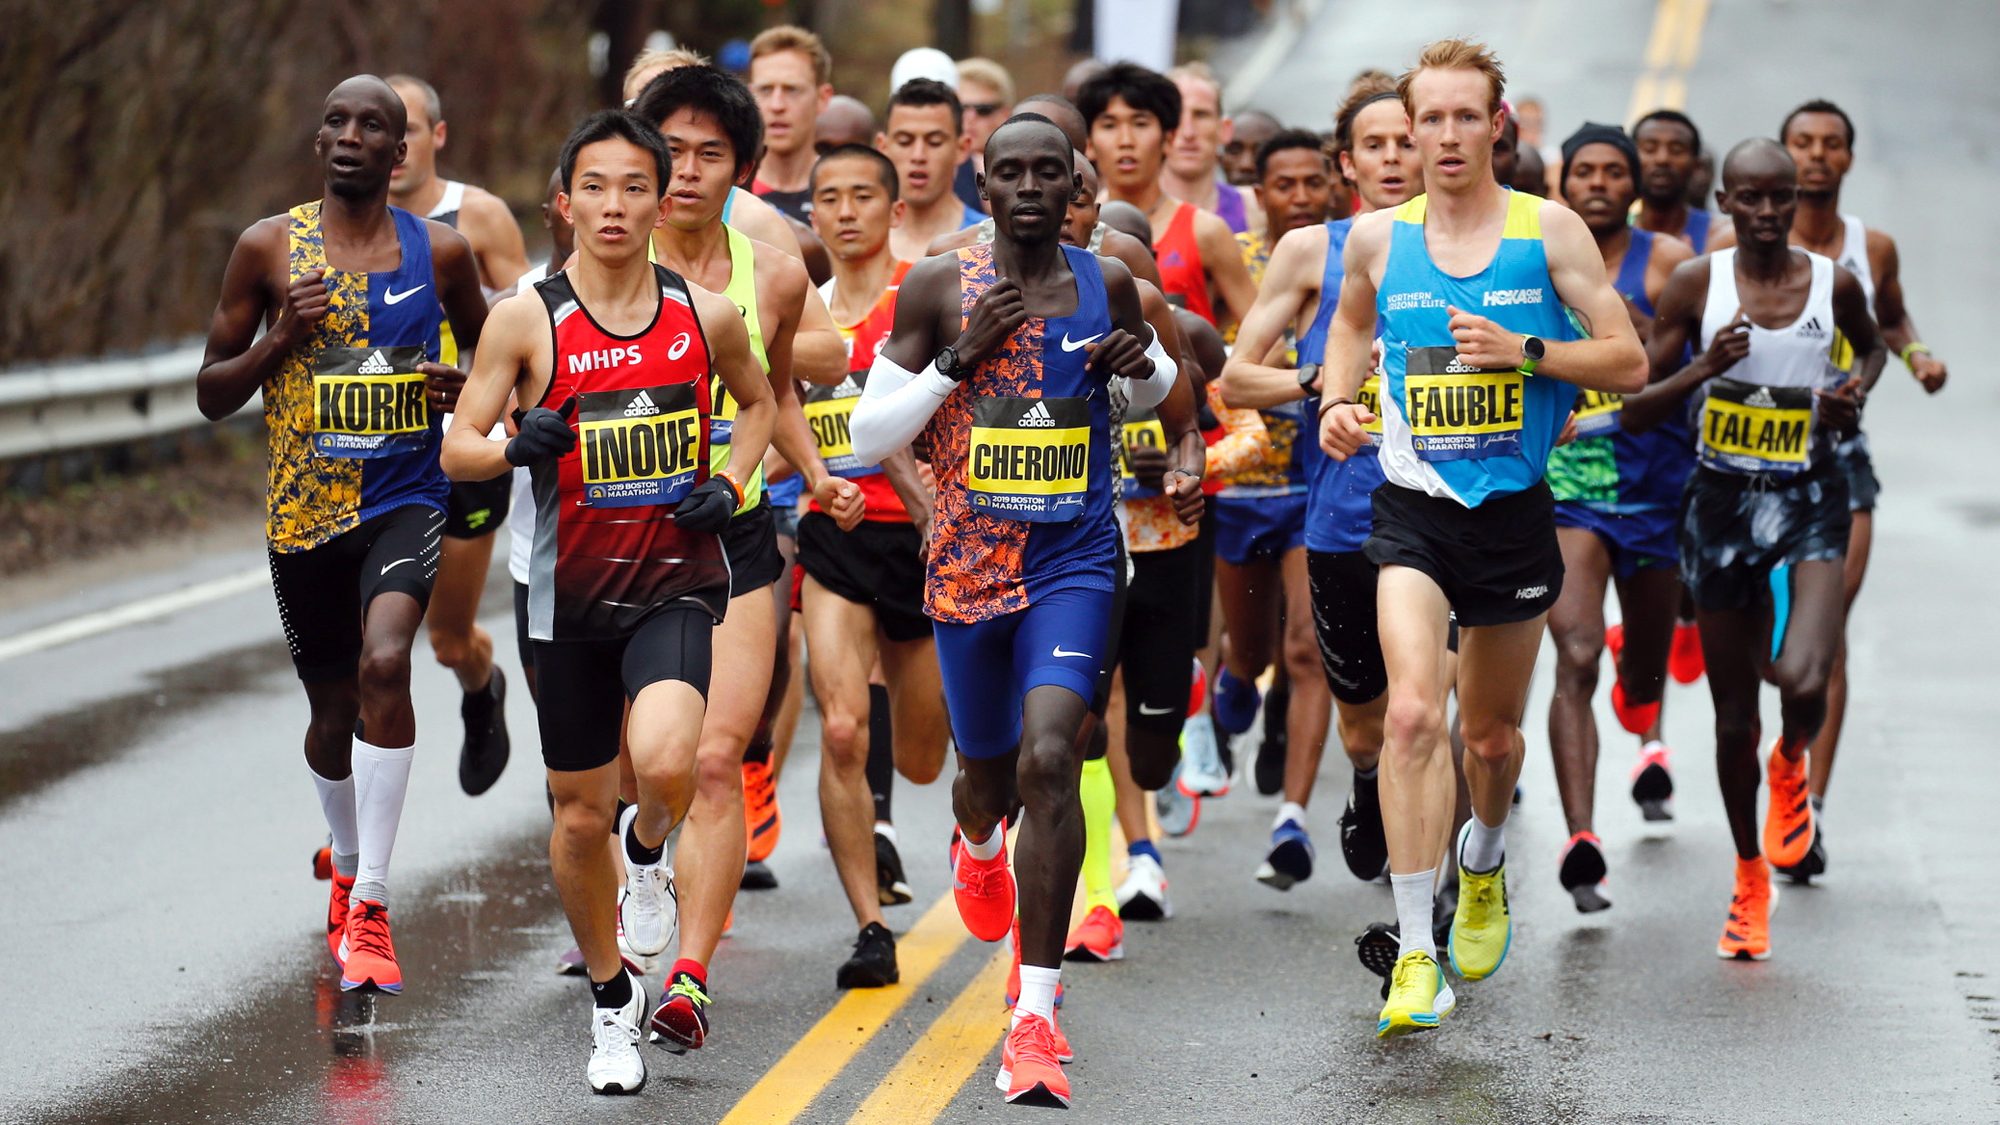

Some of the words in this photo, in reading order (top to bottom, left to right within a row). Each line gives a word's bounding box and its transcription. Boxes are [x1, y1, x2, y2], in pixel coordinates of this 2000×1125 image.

[1421, 299, 1446, 308] ELITE
[568, 345, 643, 374] MHPS
[358, 365, 394, 374] adidas
[320, 381, 426, 432] KORIR
[1410, 383, 1520, 428] FAUBLE
[624, 405, 660, 417] adidas
[1018, 418, 1056, 427] adidas
[1708, 409, 1807, 453] TALAM
[336, 441, 384, 449] MARATHO
[1445, 436, 1475, 444] BOSTON
[585, 416, 697, 480] INOUE
[1428, 443, 1476, 451] MARATHON
[974, 443, 1086, 481] CHERONO
[607, 483, 625, 491] 2019
[625, 481, 658, 489] BOSTON
[607, 488, 659, 498] MARATHON
[992, 495, 1009, 503] 2019
[1010, 496, 1045, 504] BOSTON
[992, 503, 1045, 512] MARATHON
